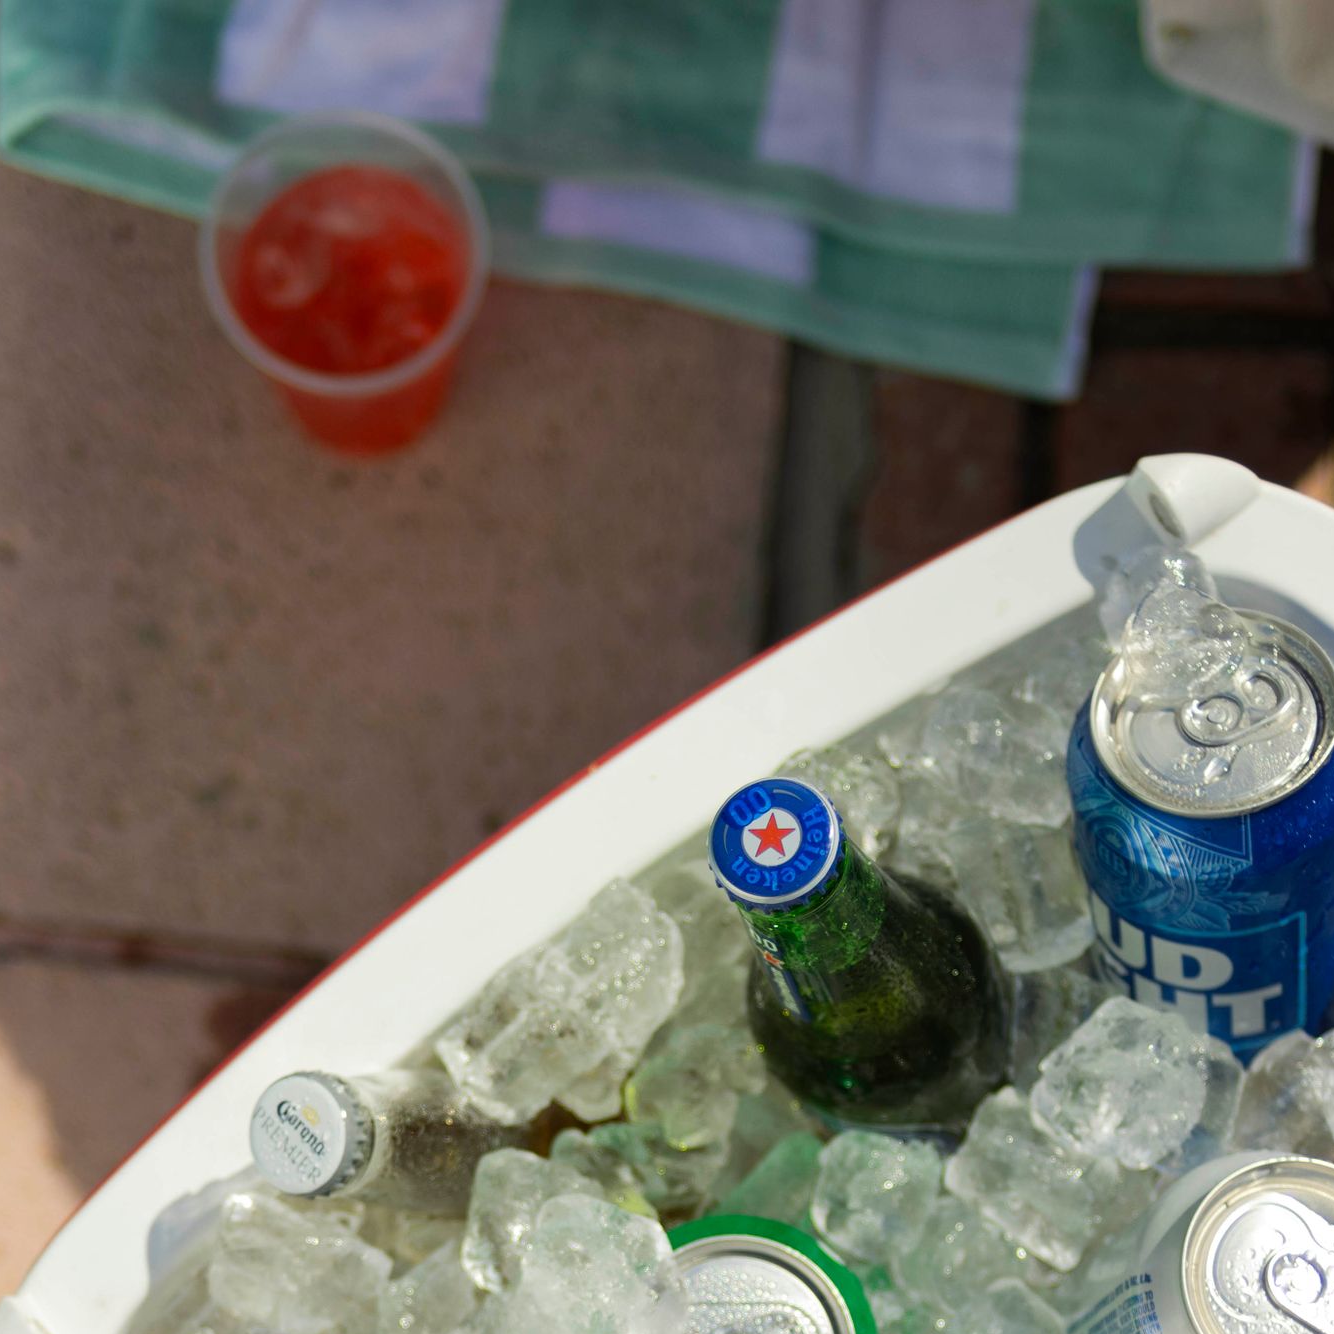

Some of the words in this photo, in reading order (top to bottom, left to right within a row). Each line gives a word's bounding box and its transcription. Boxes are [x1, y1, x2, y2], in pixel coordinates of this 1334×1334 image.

[731, 803, 828, 891] Heineken
[1091, 888, 1233, 991] UD
[253, 1106, 322, 1184] PREMIER
[277, 1100, 325, 1156] Corona
